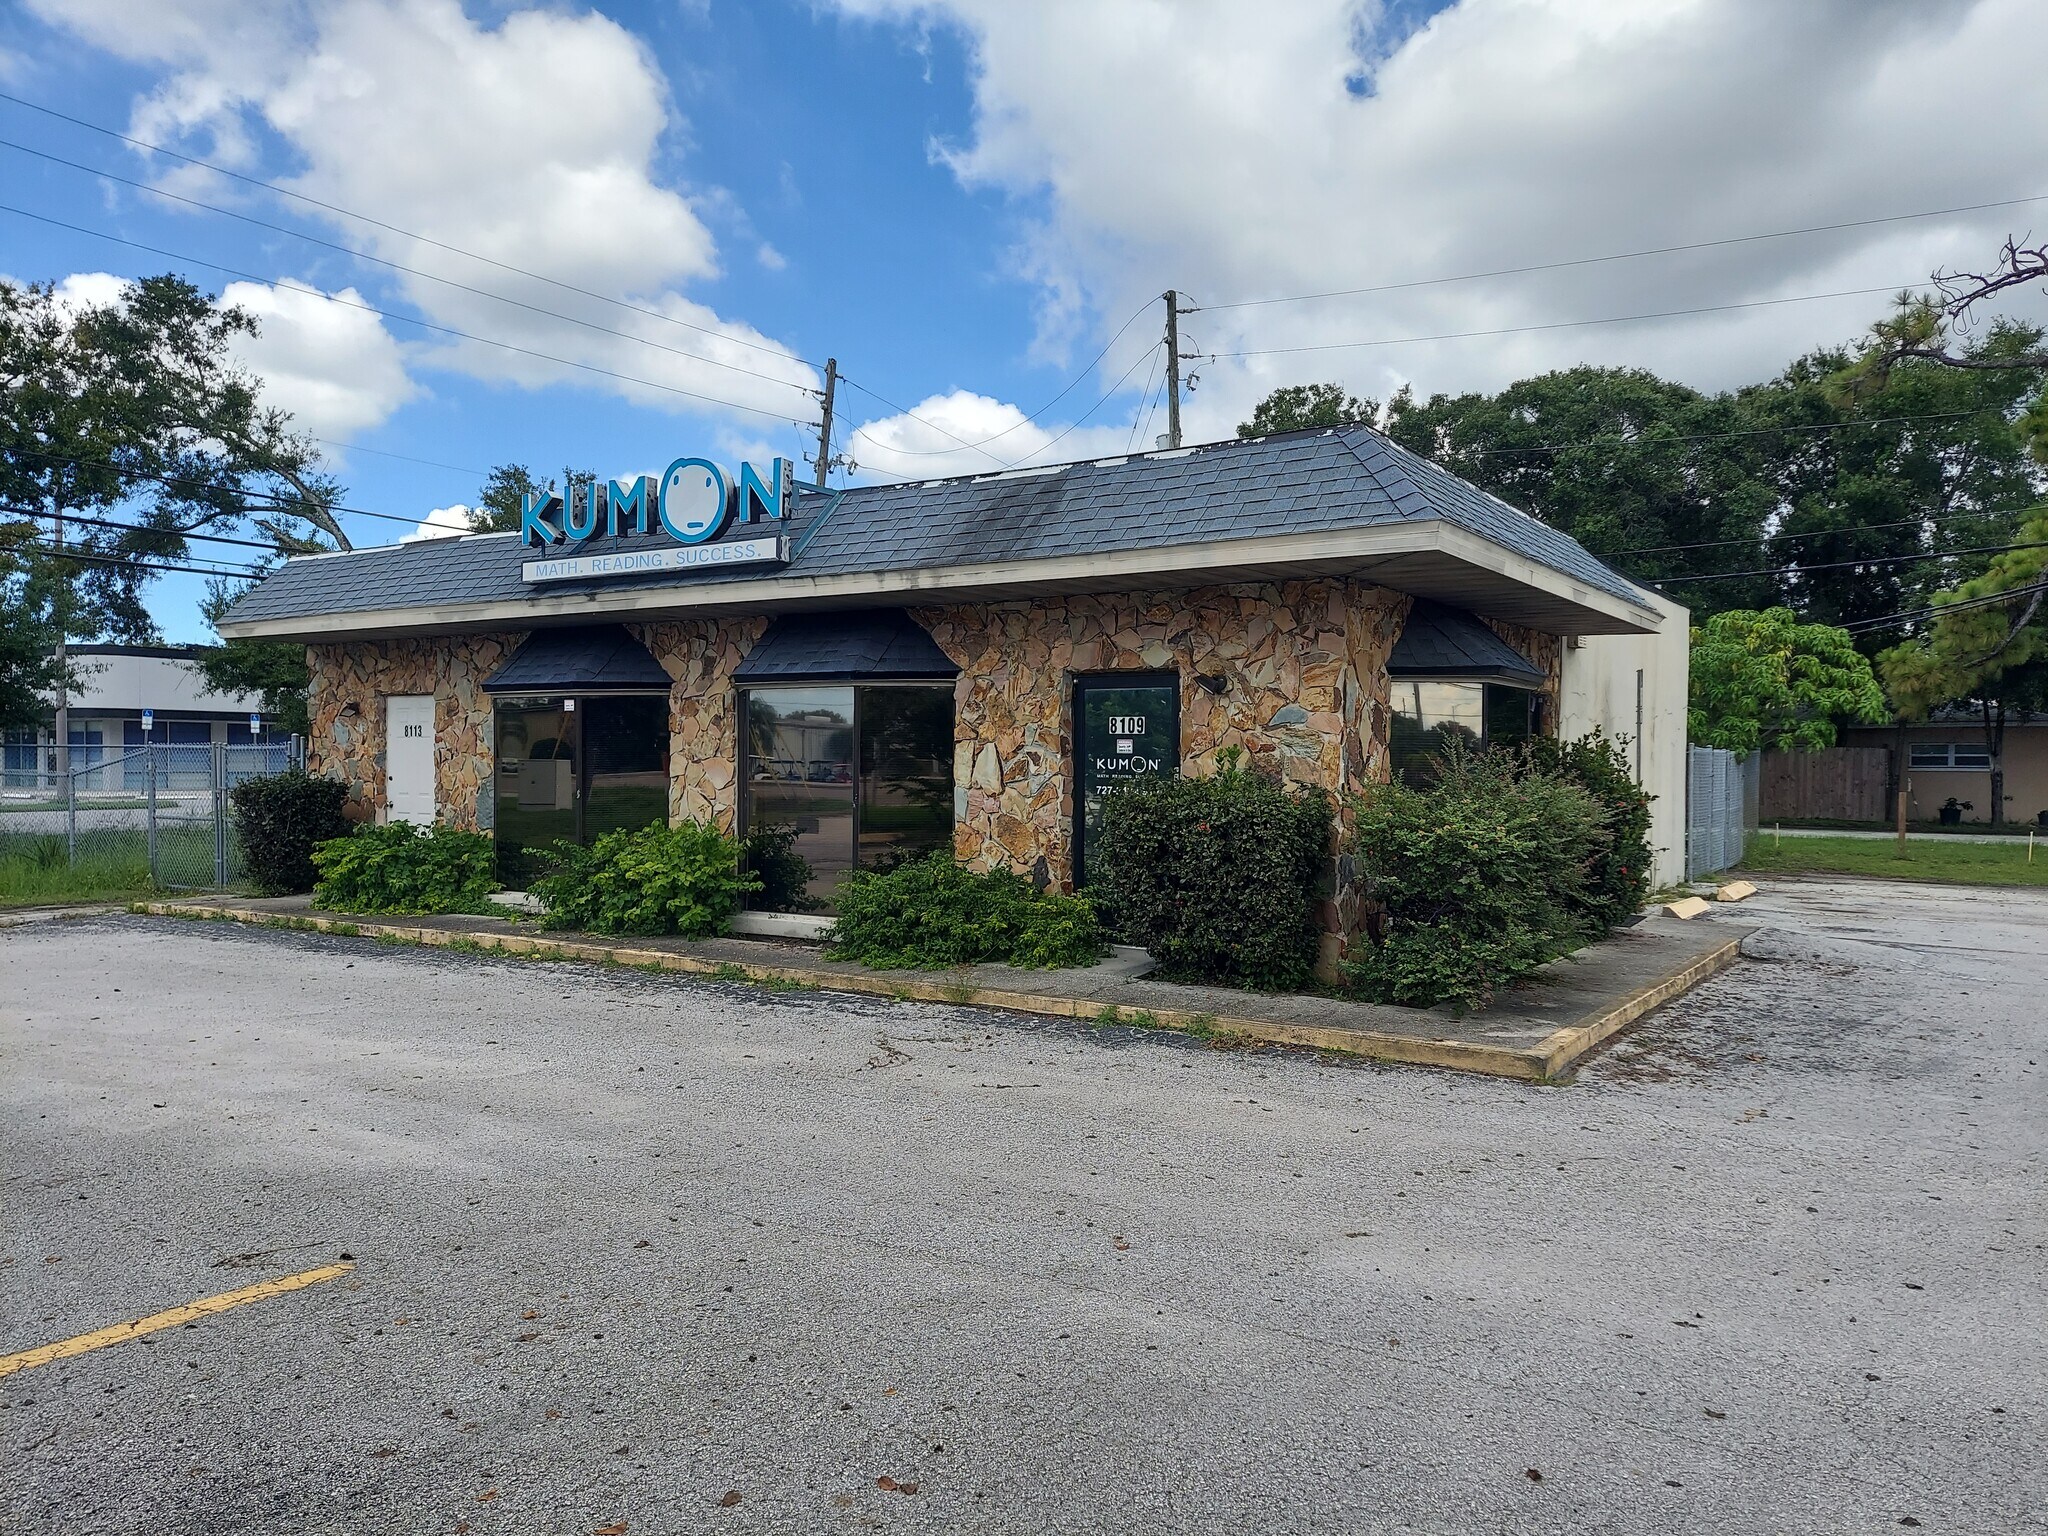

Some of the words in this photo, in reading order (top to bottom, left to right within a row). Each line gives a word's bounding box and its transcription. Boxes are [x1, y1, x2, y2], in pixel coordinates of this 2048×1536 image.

[522, 457, 787, 545] KUMON
[535, 560, 584, 577] MATH.
[676, 544, 762, 565] SUCCESS.
[404, 725, 422, 737] 8113
[1110, 717, 1144, 734] 8109
[1096, 756, 1159, 773] KUMON
